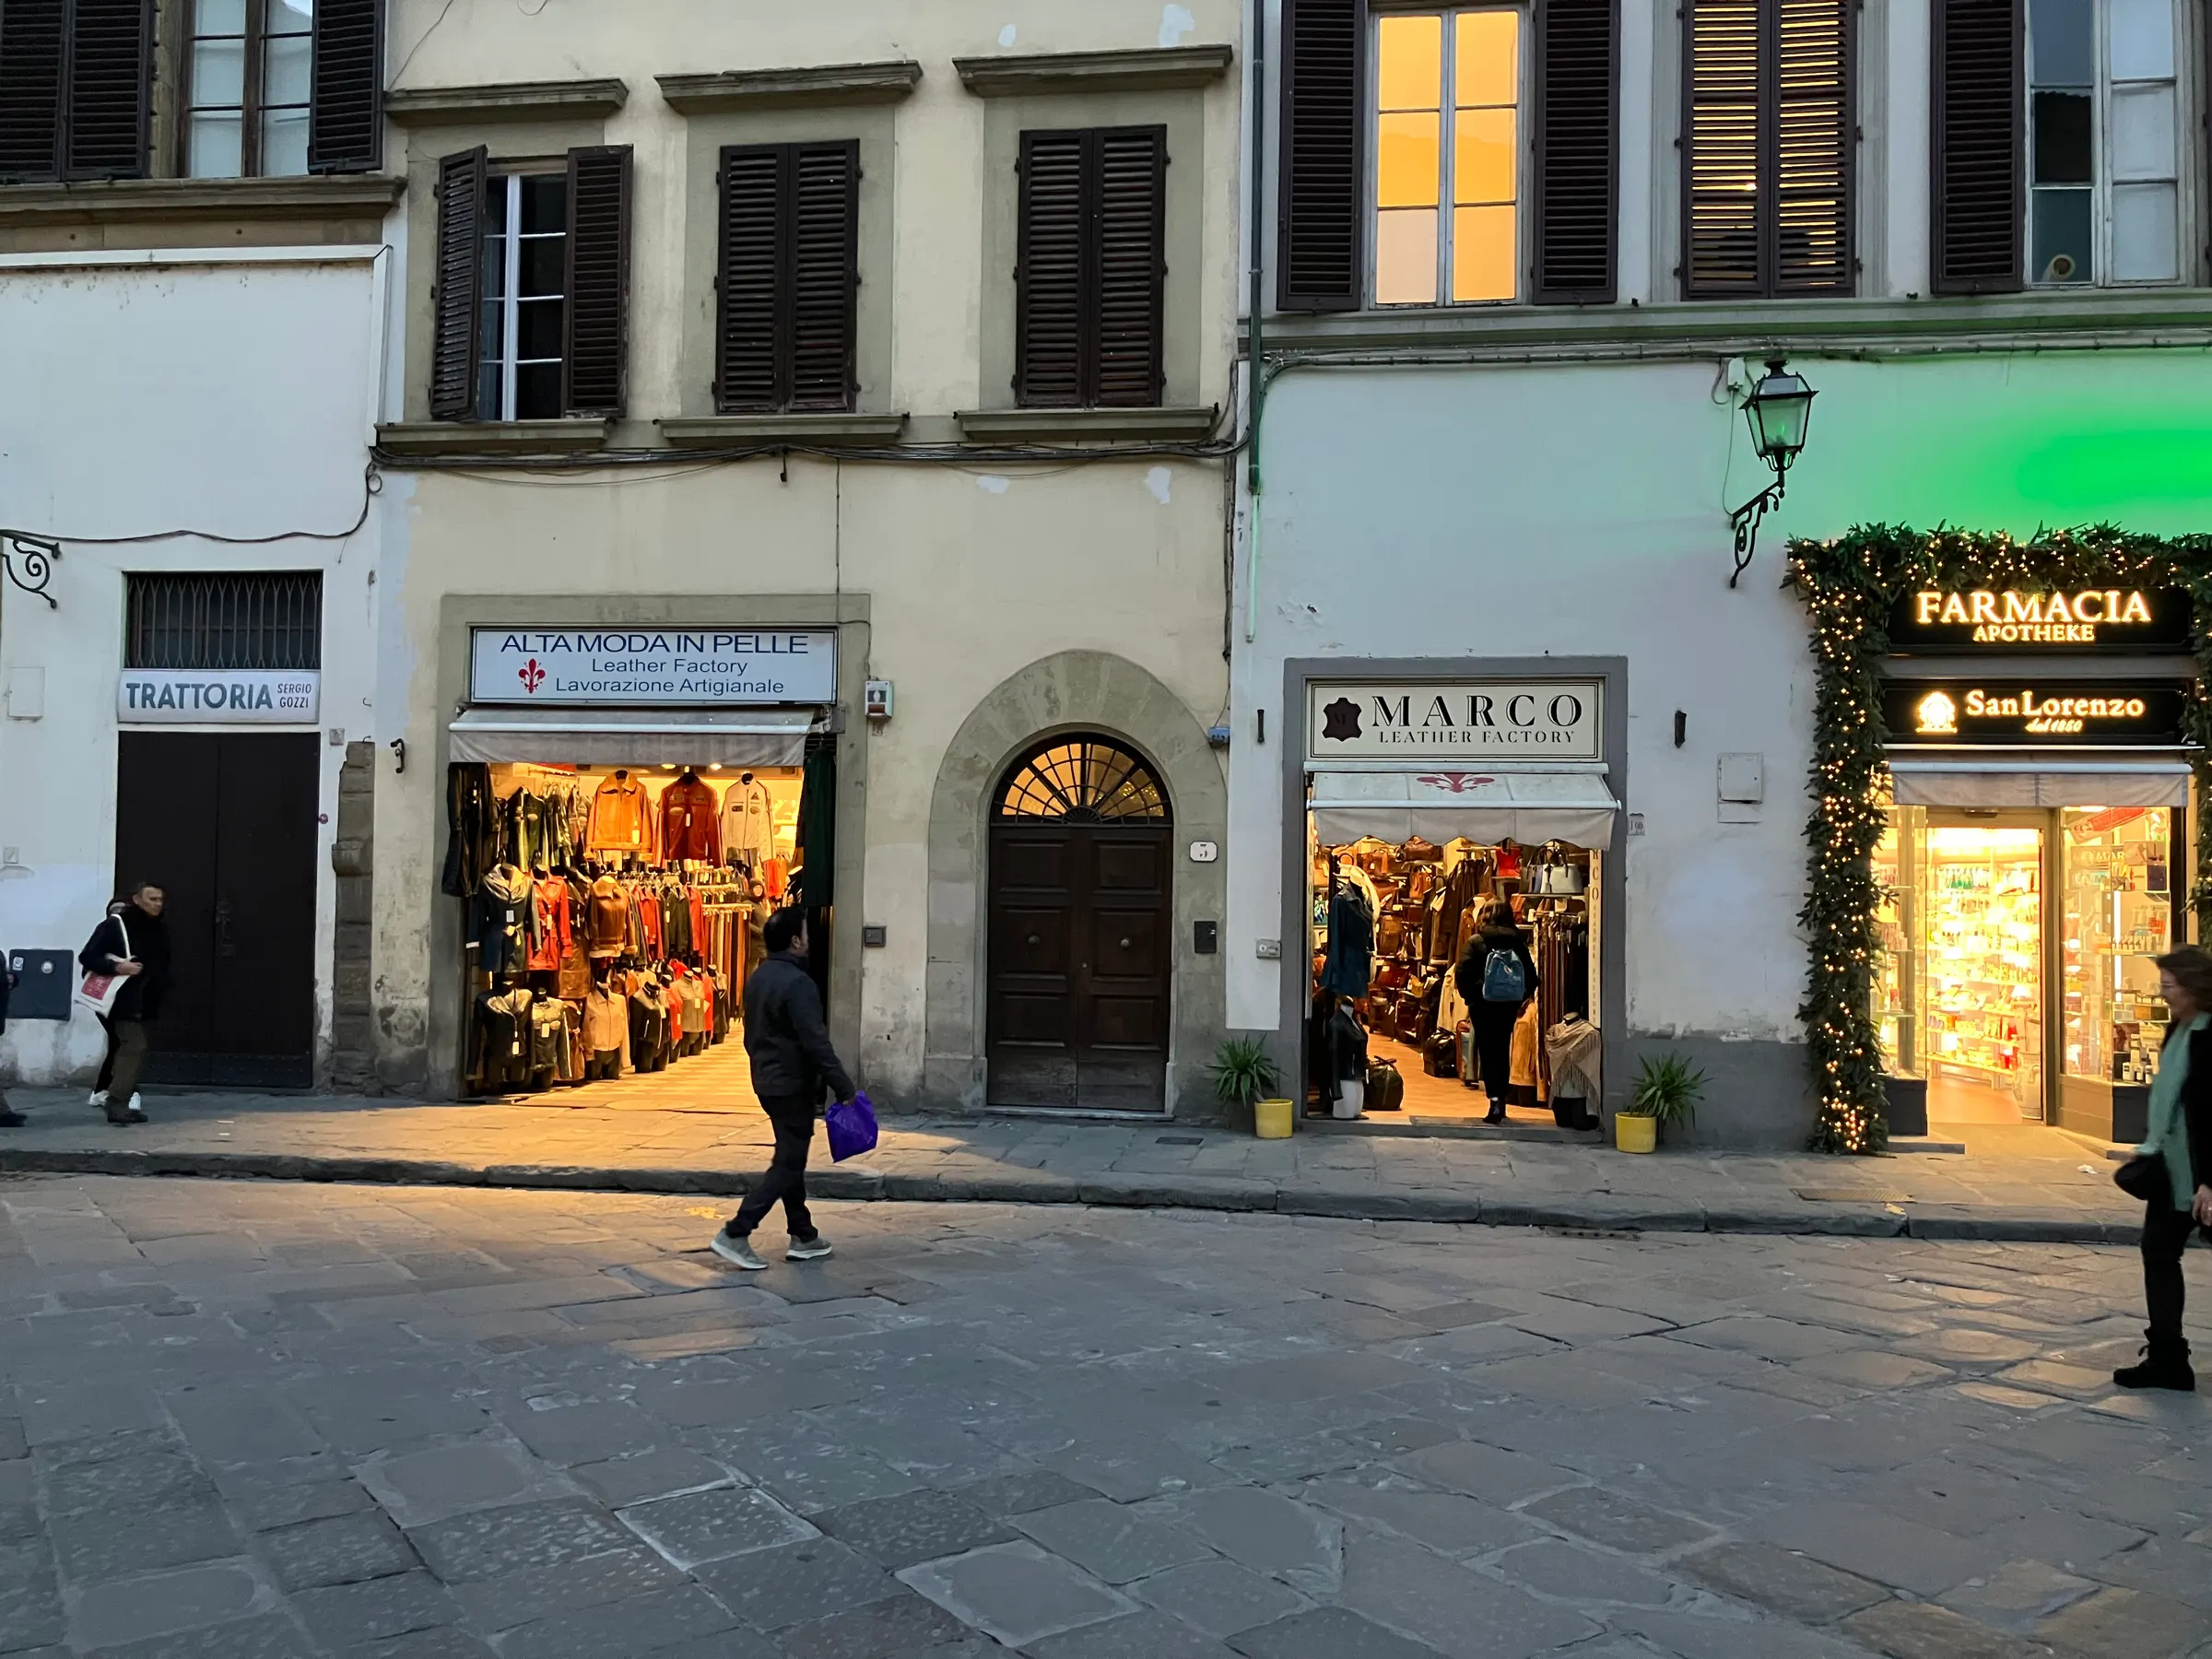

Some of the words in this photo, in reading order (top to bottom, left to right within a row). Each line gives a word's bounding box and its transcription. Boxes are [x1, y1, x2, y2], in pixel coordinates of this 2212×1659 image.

[1917, 591, 2151, 624] FARMACIA
[1973, 624, 2095, 642] APOTHEKE
[500, 634, 572, 653] ALTA
[577, 634, 669, 653] MODA
[677, 635, 703, 653] IN
[712, 635, 808, 654] PELLE
[592, 658, 665, 673] Leather
[674, 659, 748, 677] Factory
[126, 683, 273, 709] TRATTORIA
[277, 683, 312, 694] SERGIO
[556, 678, 674, 692] Lavorazione
[679, 678, 784, 696] Artigianale
[279, 697, 310, 709] GOZZI
[1371, 695, 1583, 727] MARCO
[1966, 689, 2019, 716] San
[2021, 690, 2145, 716] Lorenzo
[1380, 731, 1472, 743] LEATHER
[1482, 731, 1574, 743] FACTORY
